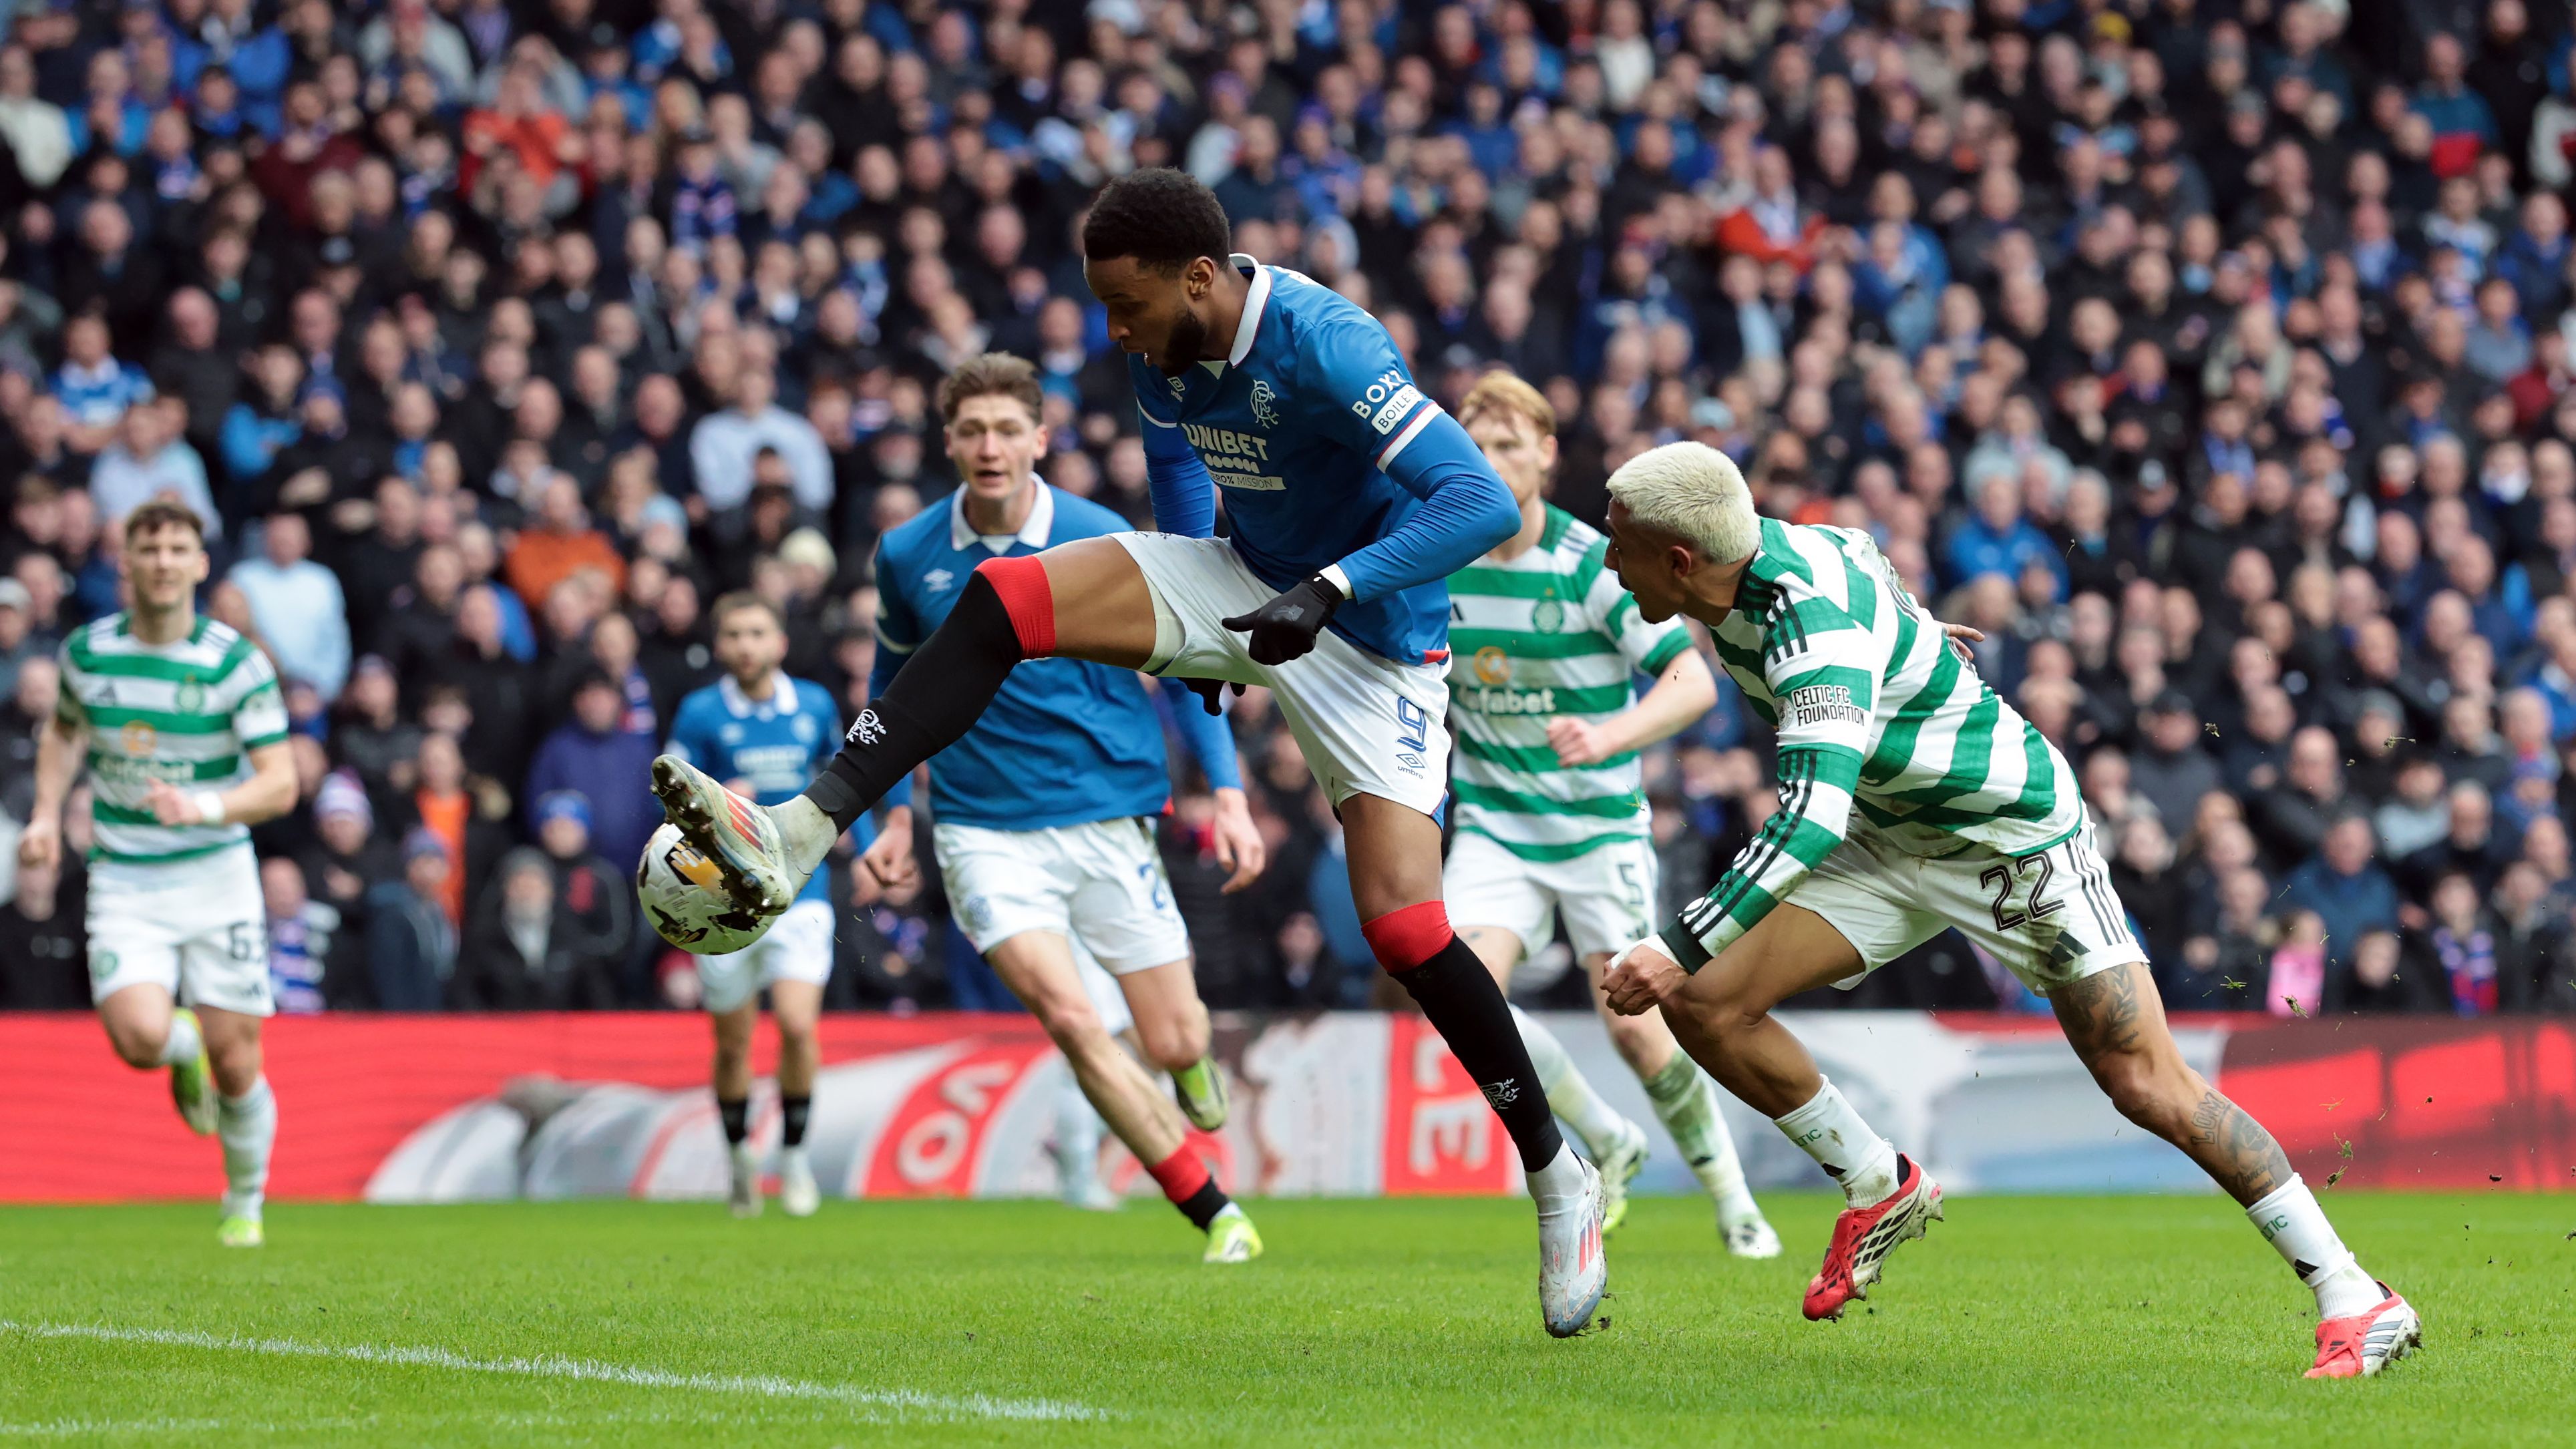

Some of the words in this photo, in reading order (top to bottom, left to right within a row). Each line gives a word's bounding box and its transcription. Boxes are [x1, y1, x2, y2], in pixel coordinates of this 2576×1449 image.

[1181, 423, 1269, 461] UNIBET
[1237, 476, 1273, 489] MISSION
[1793, 686, 1833, 708] CELTIC
[1835, 686, 1849, 703] FC
[1397, 695, 1427, 753] 9
[1797, 704, 1865, 727] FOUNDATION
[1397, 766, 1423, 780] umbro
[1618, 863, 1644, 905] 5
[1980, 850, 2067, 934] 22
